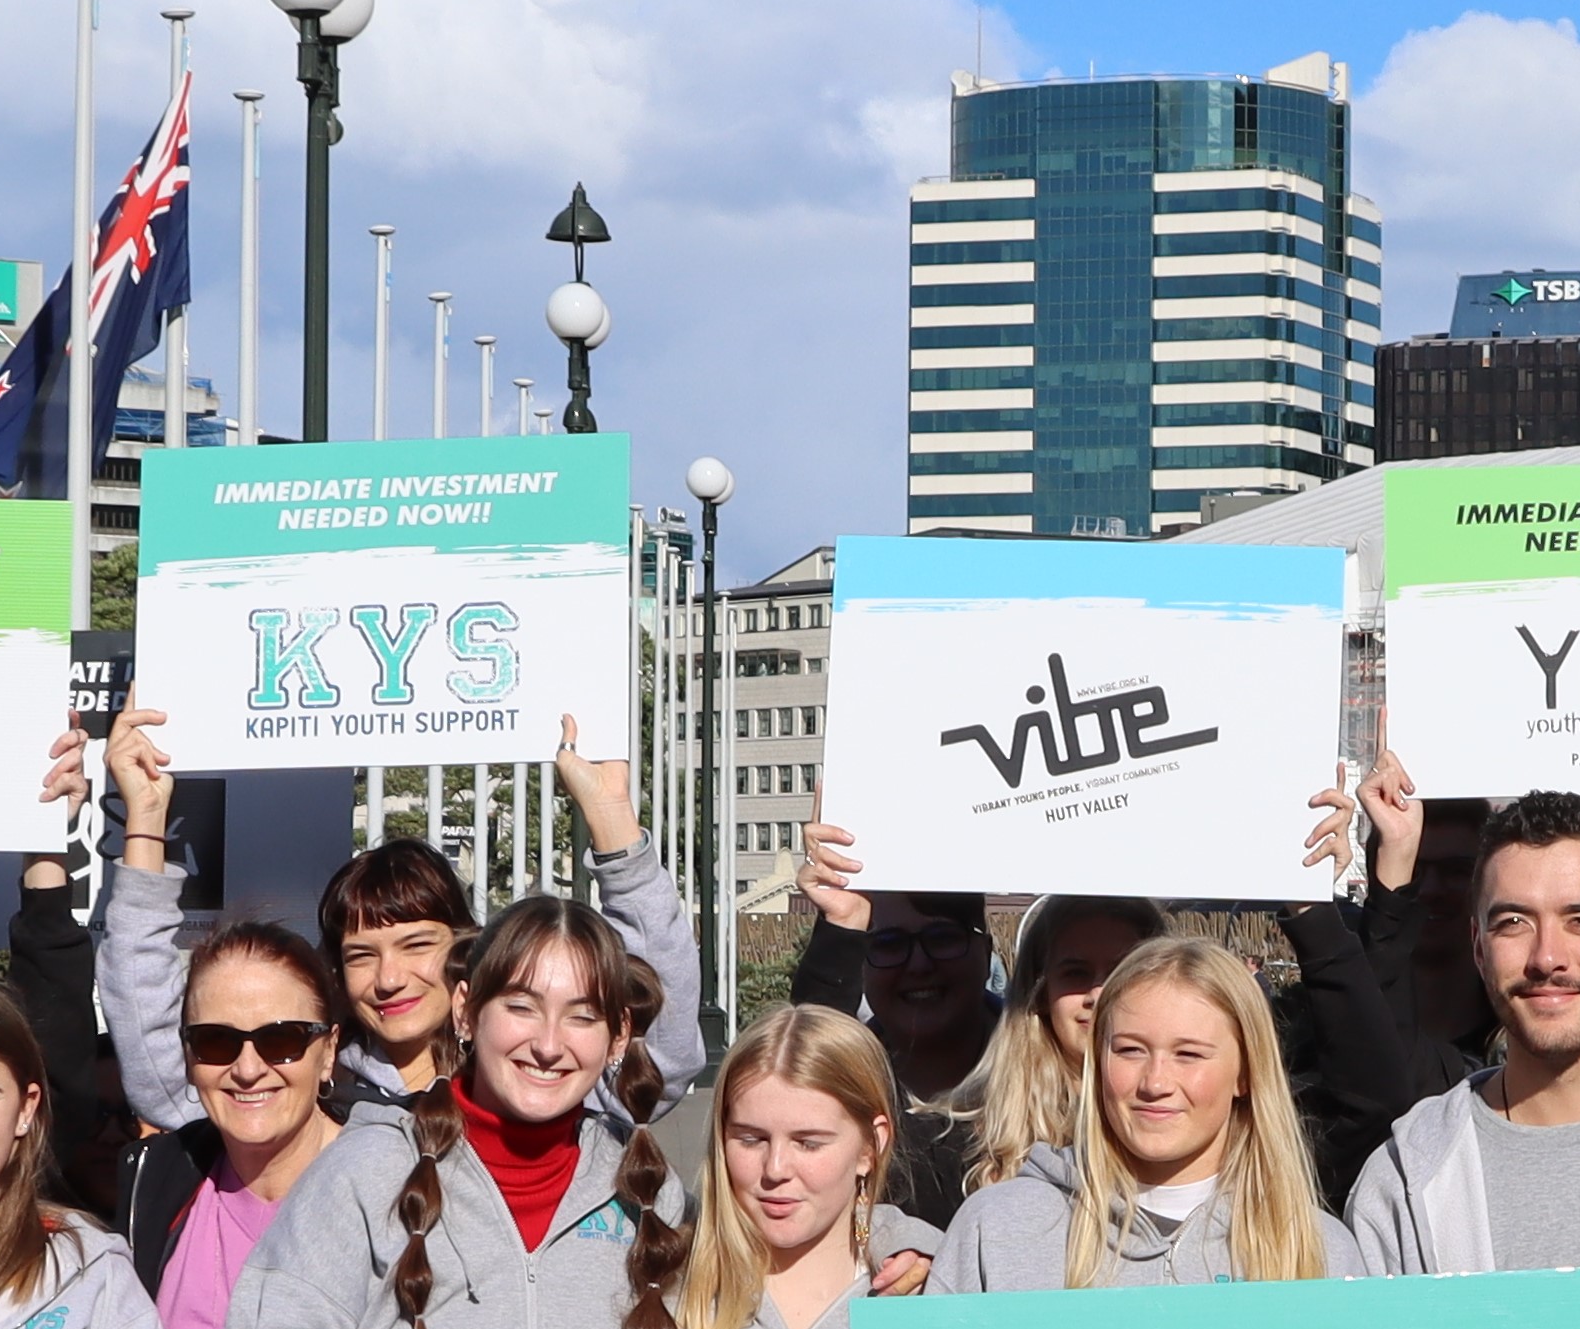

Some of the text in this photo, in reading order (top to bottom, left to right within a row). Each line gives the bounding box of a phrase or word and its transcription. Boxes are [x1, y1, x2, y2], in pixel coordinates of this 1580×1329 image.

[1532, 279, 1580, 301] TSB
[214, 471, 559, 505] IMMEDIATE INVESTMENT
[277, 502, 492, 531] NEEDED NOW!!
[246, 601, 521, 711] KYS
[1076, 675, 1151, 698] WWW.VIBE.ORG.NZ
[245, 708, 520, 740] KAPITI YOUTH SUPPORT
[941, 652, 1218, 789] vibe
[972, 798, 1012, 814] VIBRANT
[1014, 791, 1045, 805] YOUNG
[1085, 774, 1121, 789] VIBRANT
[1122, 761, 1181, 781] COMMUNITIES
[1045, 793, 1130, 823] HUTT VALLEY
